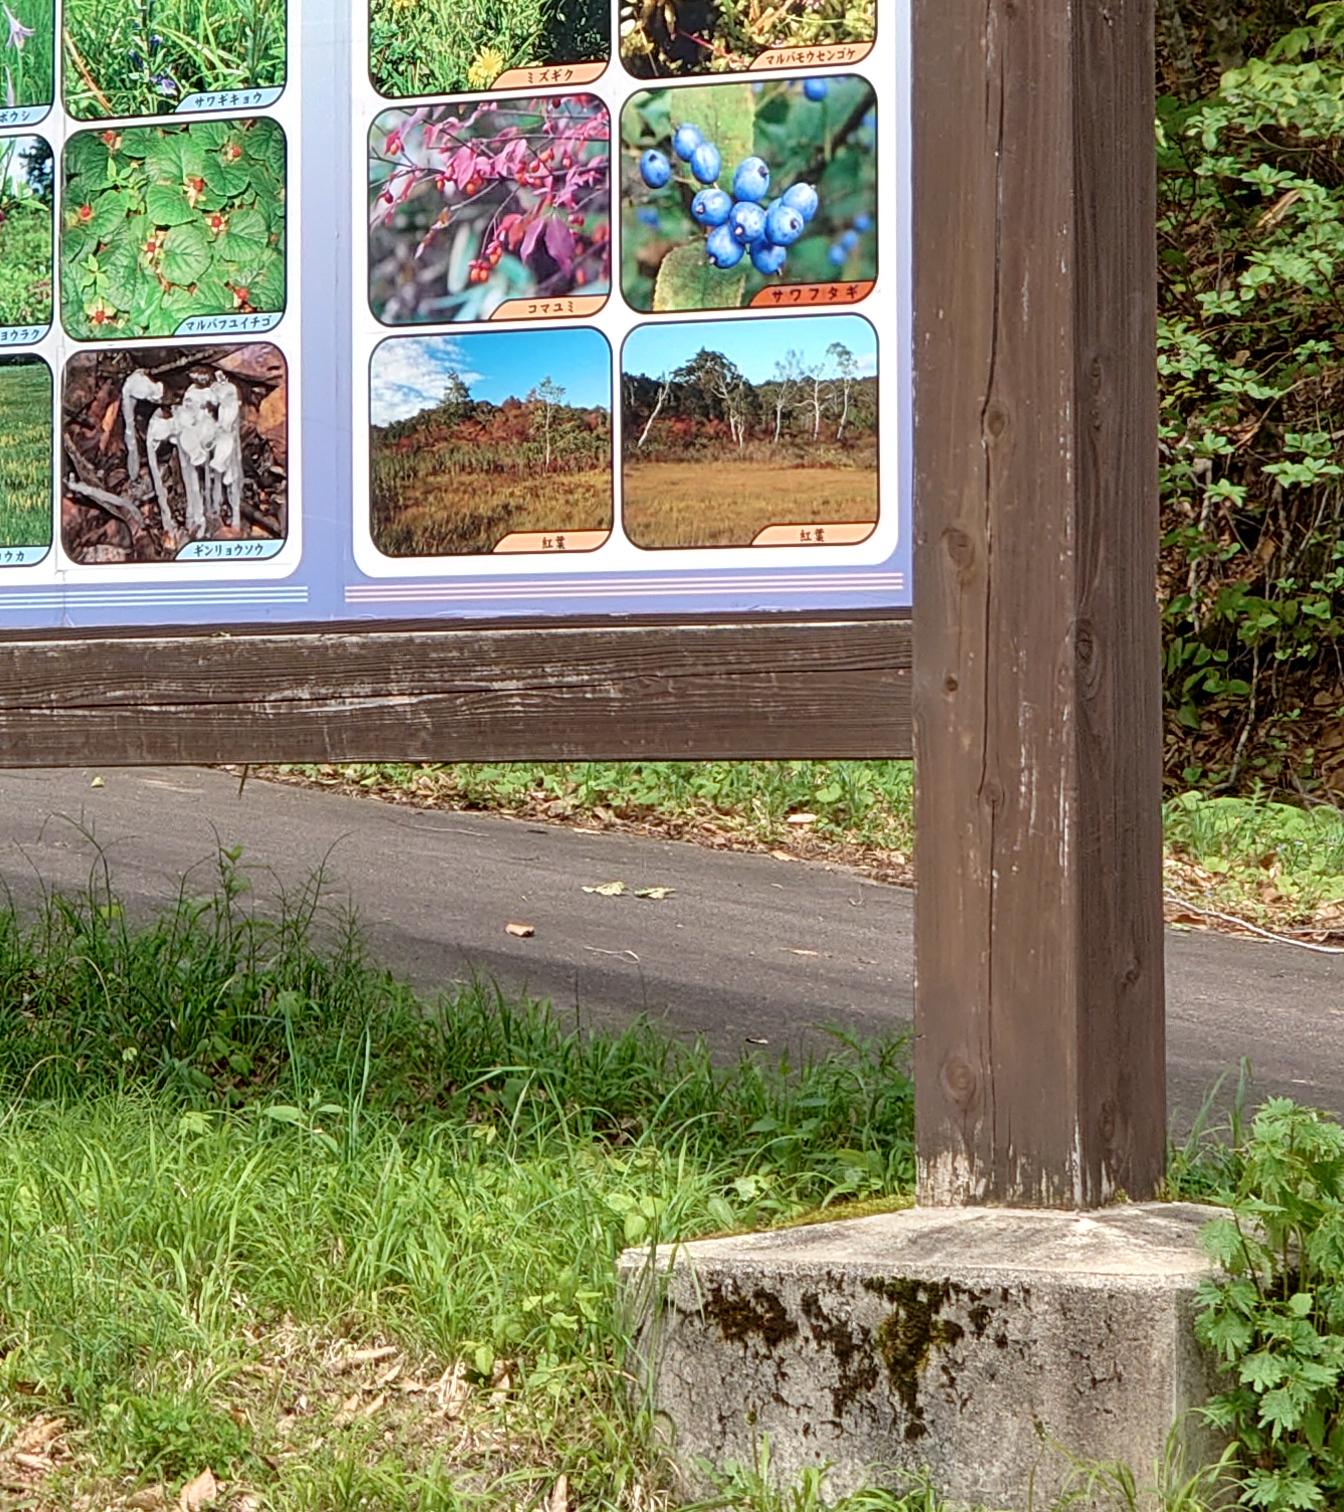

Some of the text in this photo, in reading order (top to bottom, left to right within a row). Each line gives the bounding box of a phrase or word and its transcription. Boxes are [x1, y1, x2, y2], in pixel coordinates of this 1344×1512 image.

[766, 48, 856, 65] マルバモウセンゴケ
[528, 69, 574, 84] ミズギク
[195, 92, 263, 107] サワギキョウ
[772, 285, 860, 303] サワフタギ
[528, 301, 574, 314] コマユミ
[185, 315, 272, 331] マルバフユイチゴ
[800, 528, 825, 542] 紅葉
[193, 543, 264, 556] ギンリョウソウ
[542, 536, 566, 550] 紅葉
